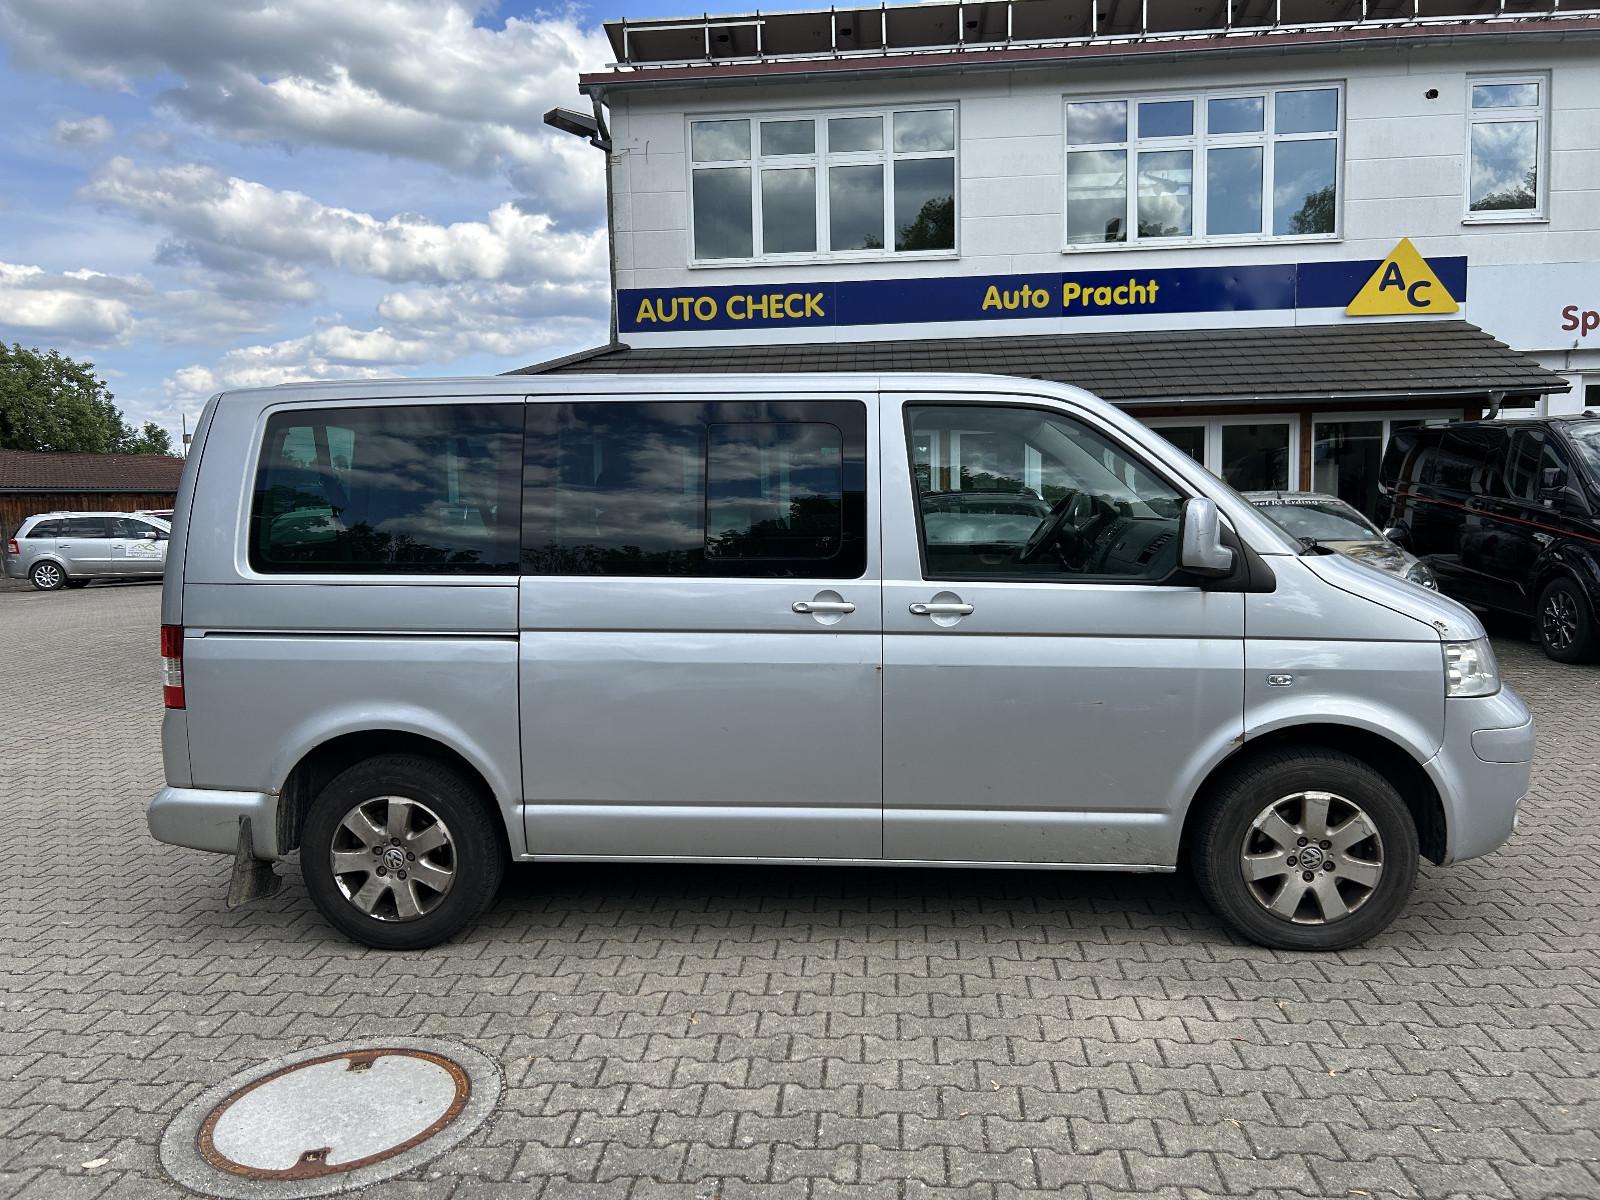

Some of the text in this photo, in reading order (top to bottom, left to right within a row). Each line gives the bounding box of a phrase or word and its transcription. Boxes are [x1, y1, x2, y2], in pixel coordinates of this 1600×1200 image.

[636, 293, 824, 322] AUTO CHECK
[982, 279, 1159, 310] Auto Pracht
